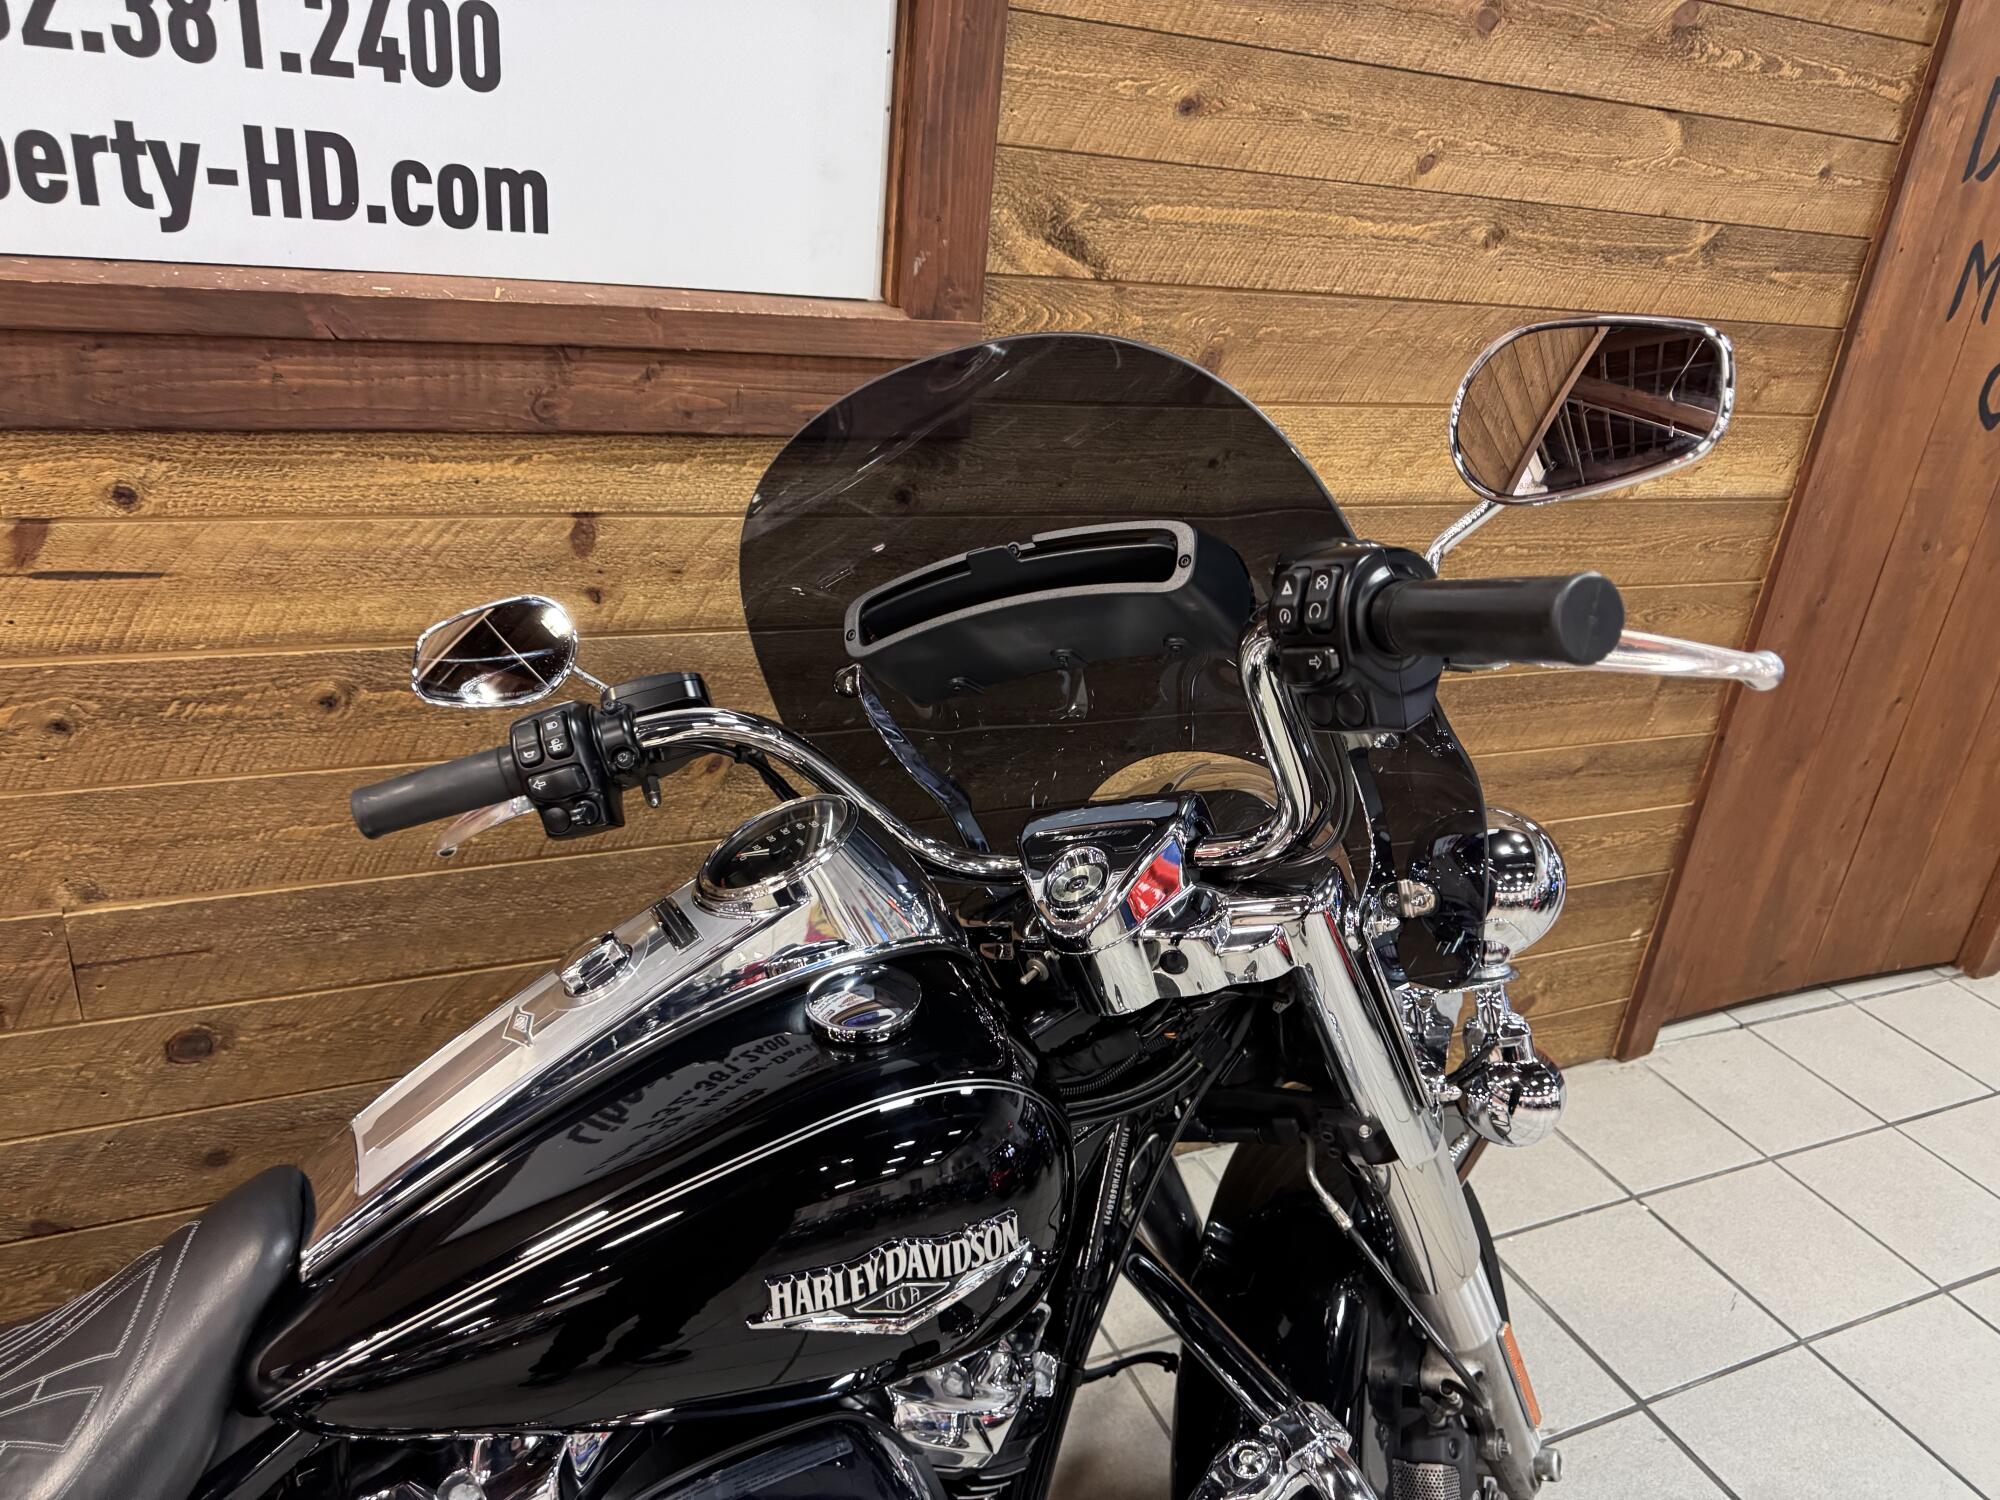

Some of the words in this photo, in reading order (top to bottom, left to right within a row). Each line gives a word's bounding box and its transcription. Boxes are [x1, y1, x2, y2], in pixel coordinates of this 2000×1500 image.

[0, 0, 501, 93] 2.381.2400
[0, 120, 549, 233] erty-HD.com
[886, 1286, 920, 1310] USA
